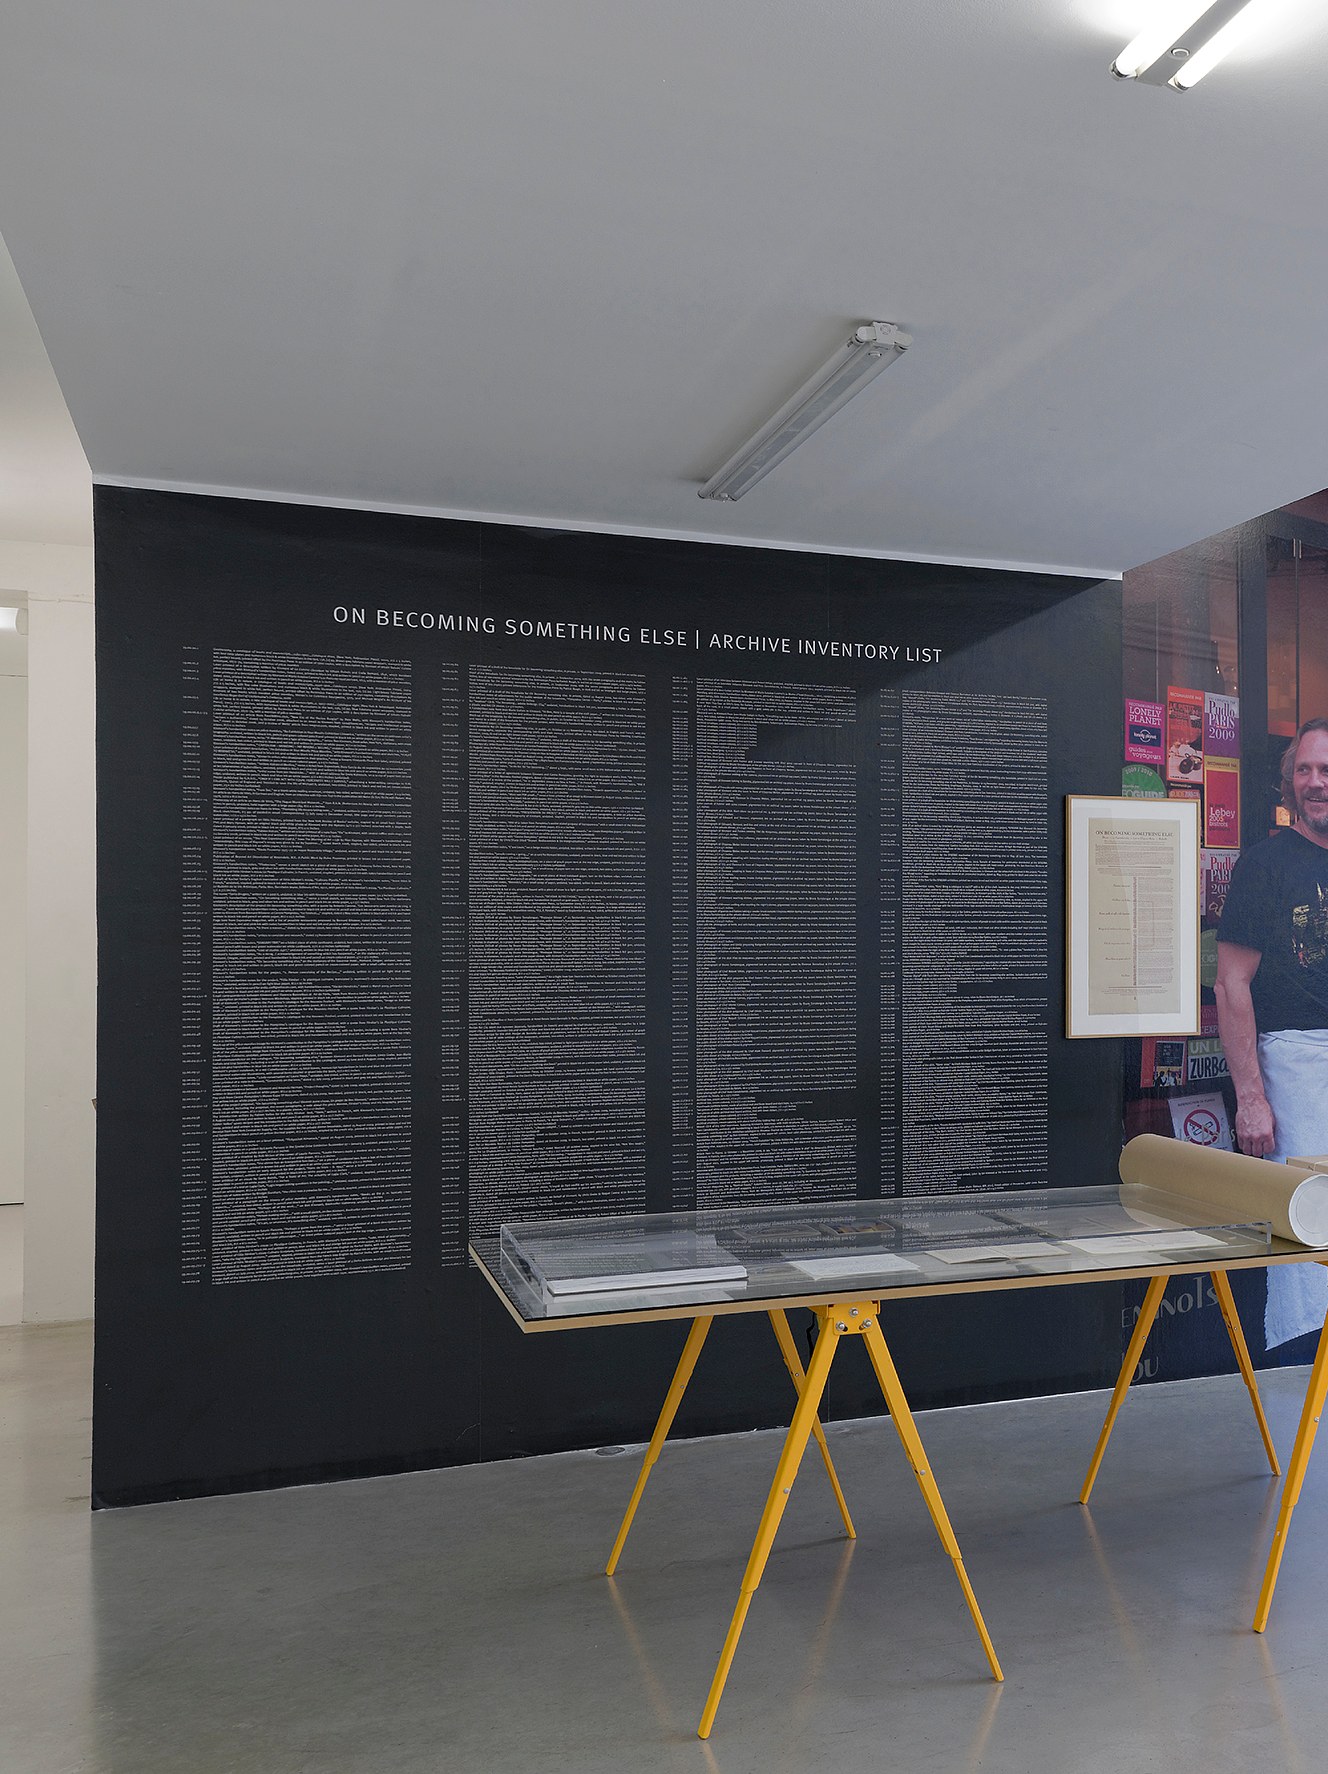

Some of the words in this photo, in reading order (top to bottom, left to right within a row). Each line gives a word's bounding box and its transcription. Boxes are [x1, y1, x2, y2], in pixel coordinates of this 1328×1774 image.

[333, 606, 366, 624] ON
[376, 608, 496, 634] BECOMING
[504, 618, 631, 643] SOMETHING
[640, 627, 687, 646] ELSE
[709, 633, 791, 653] ARCHIVE
[798, 639, 900, 660] INVENTORY
[906, 647, 943, 663] LIST
[1129, 706, 1161, 718] LONELY
[1129, 713, 1162, 725] PLANET
[1209, 712, 1235, 729] PARIS
[1209, 727, 1235, 741] 2009
[1210, 806, 1236, 819] Lebey
[1210, 869, 1232, 882] PARI
[1211, 883, 1230, 895] 200
